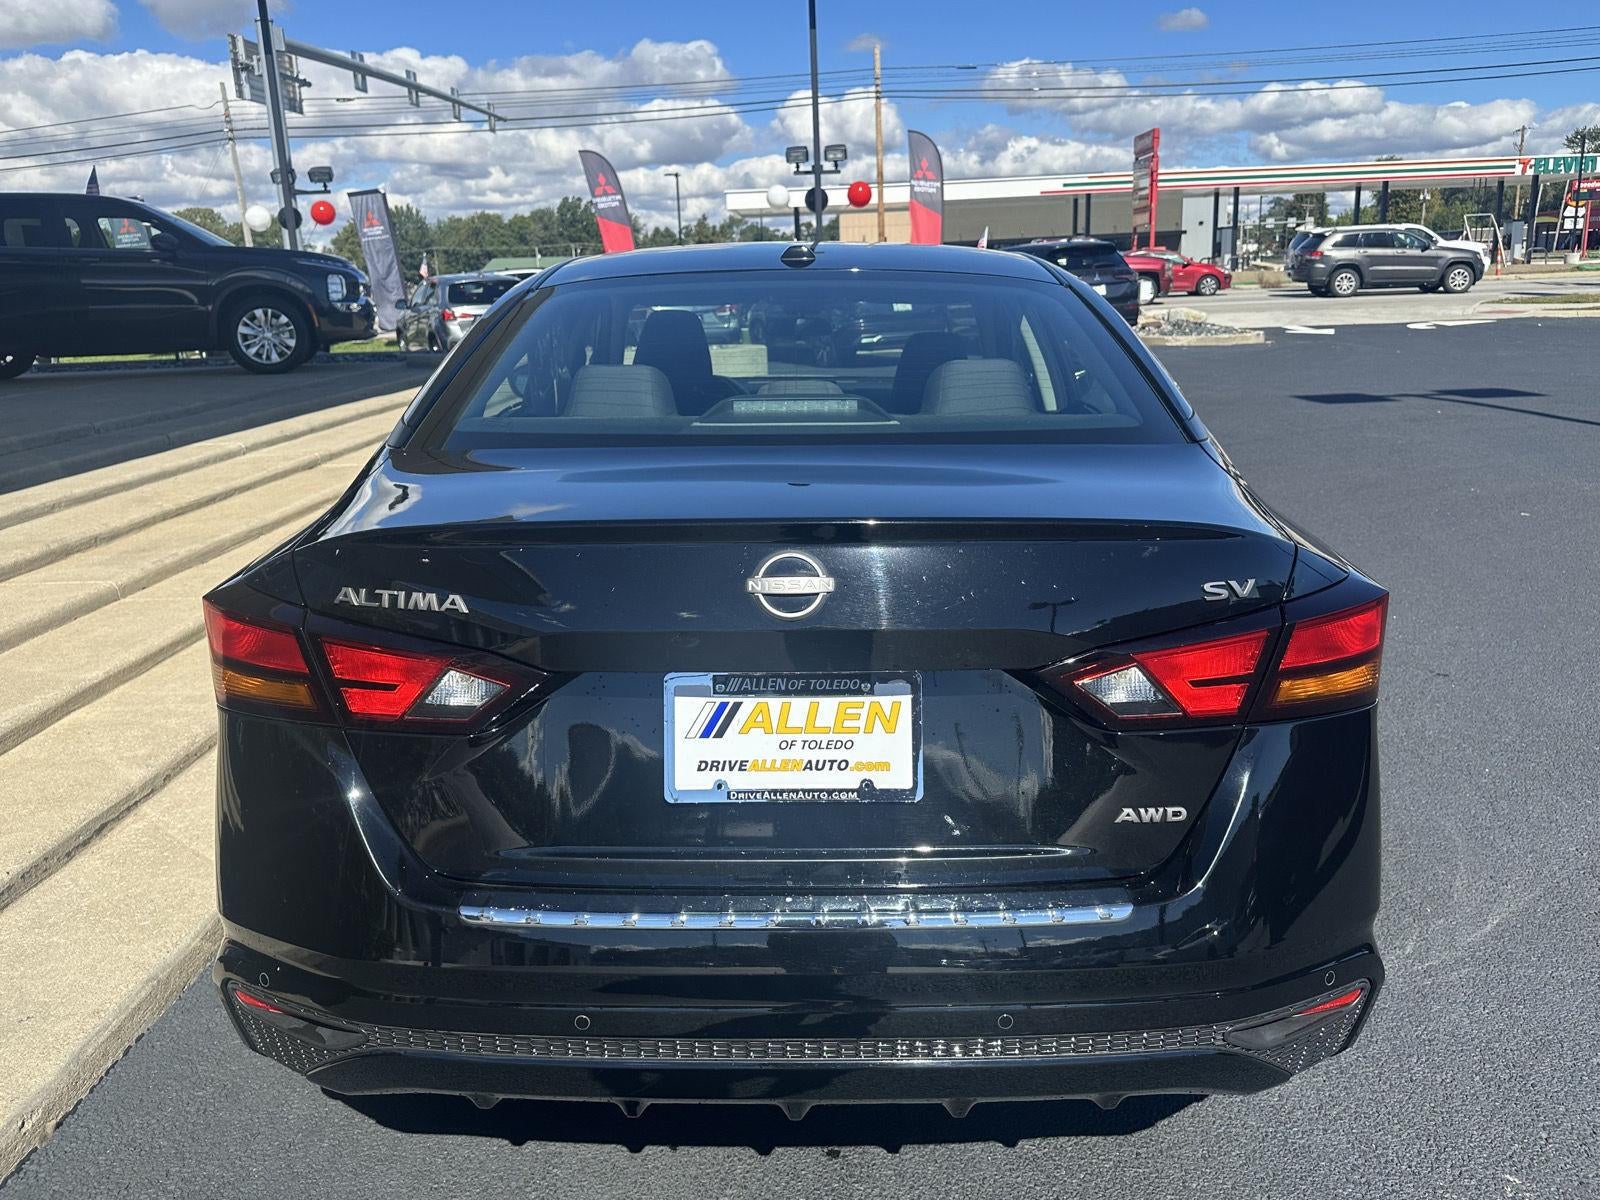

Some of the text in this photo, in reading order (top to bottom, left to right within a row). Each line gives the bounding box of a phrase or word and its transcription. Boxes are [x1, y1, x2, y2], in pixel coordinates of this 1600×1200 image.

[747, 578, 834, 593] NISSAN
[1203, 579, 1256, 601] SV
[334, 586, 470, 614] ALTIMA
[740, 678, 860, 692] ALLEN OF TOLEDO
[738, 701, 902, 735] ALLEN
[778, 739, 854, 750] OF TOLEDO
[696, 758, 891, 772] DRIVEALLENAUTO.com
[1114, 807, 1187, 823] AWD
